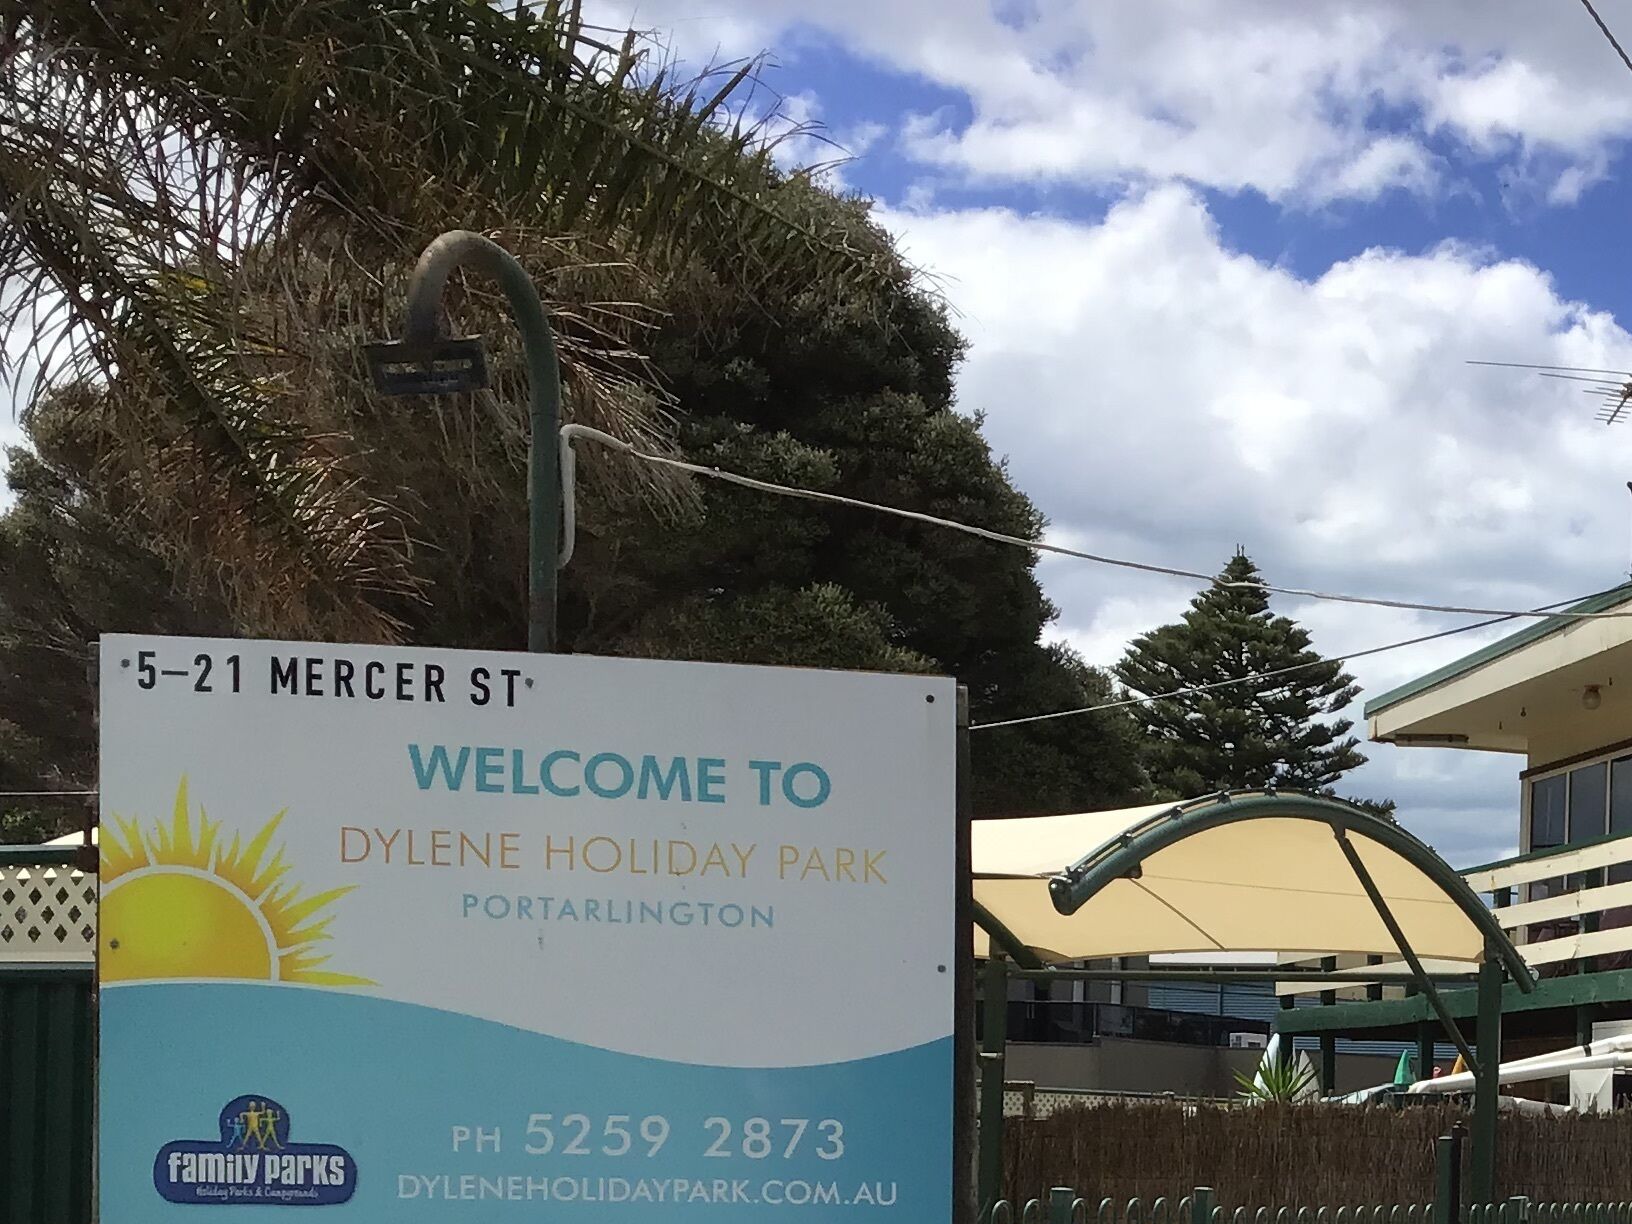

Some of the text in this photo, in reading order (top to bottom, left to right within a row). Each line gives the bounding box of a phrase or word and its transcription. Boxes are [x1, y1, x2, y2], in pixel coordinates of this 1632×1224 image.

[271, 657, 445, 702] MERCER
[471, 668, 520, 707] ST
[409, 744, 832, 808] WELCOME TO
[340, 827, 889, 882] DYLENE HOLIDAY PARK
[462, 892, 776, 928] PORTARLINGTON
[453, 1114, 843, 1159] PH 5259 2873
[168, 1153, 259, 1183] family
[398, 1175, 896, 1205] DYLENEHOLIDAYPARK.COM.AU
